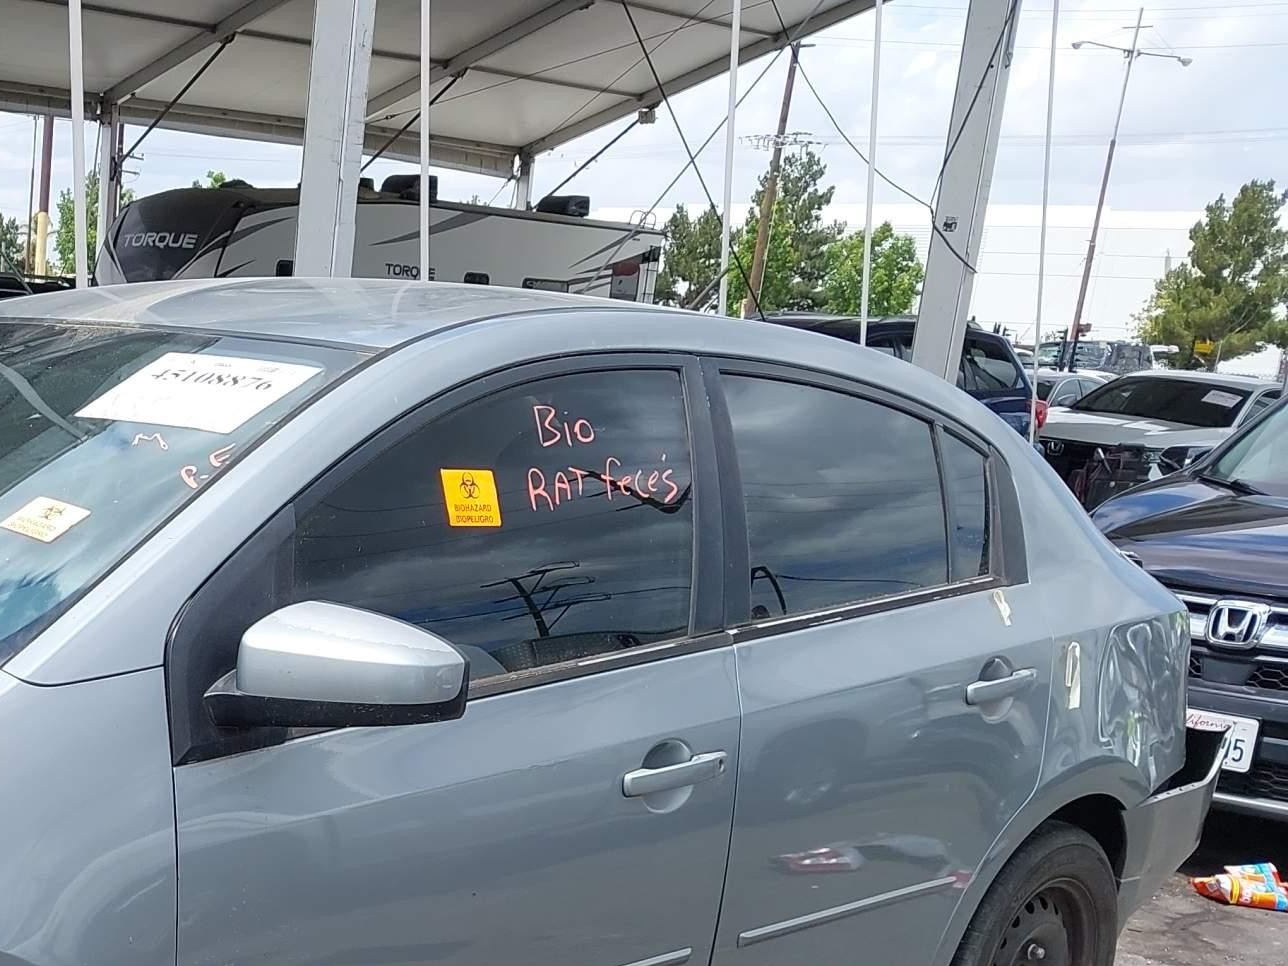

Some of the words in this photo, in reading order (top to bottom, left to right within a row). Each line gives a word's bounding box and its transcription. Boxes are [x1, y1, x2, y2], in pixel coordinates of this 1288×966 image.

[124, 232, 198, 249] TORQUE
[385, 263, 436, 281] TORQE
[152, 369, 272, 390] 45108876
[528, 467, 589, 511] RAT
[454, 504, 492, 512] BIOHAZARD
[456, 515, 494, 523] BIOPELIGRO
